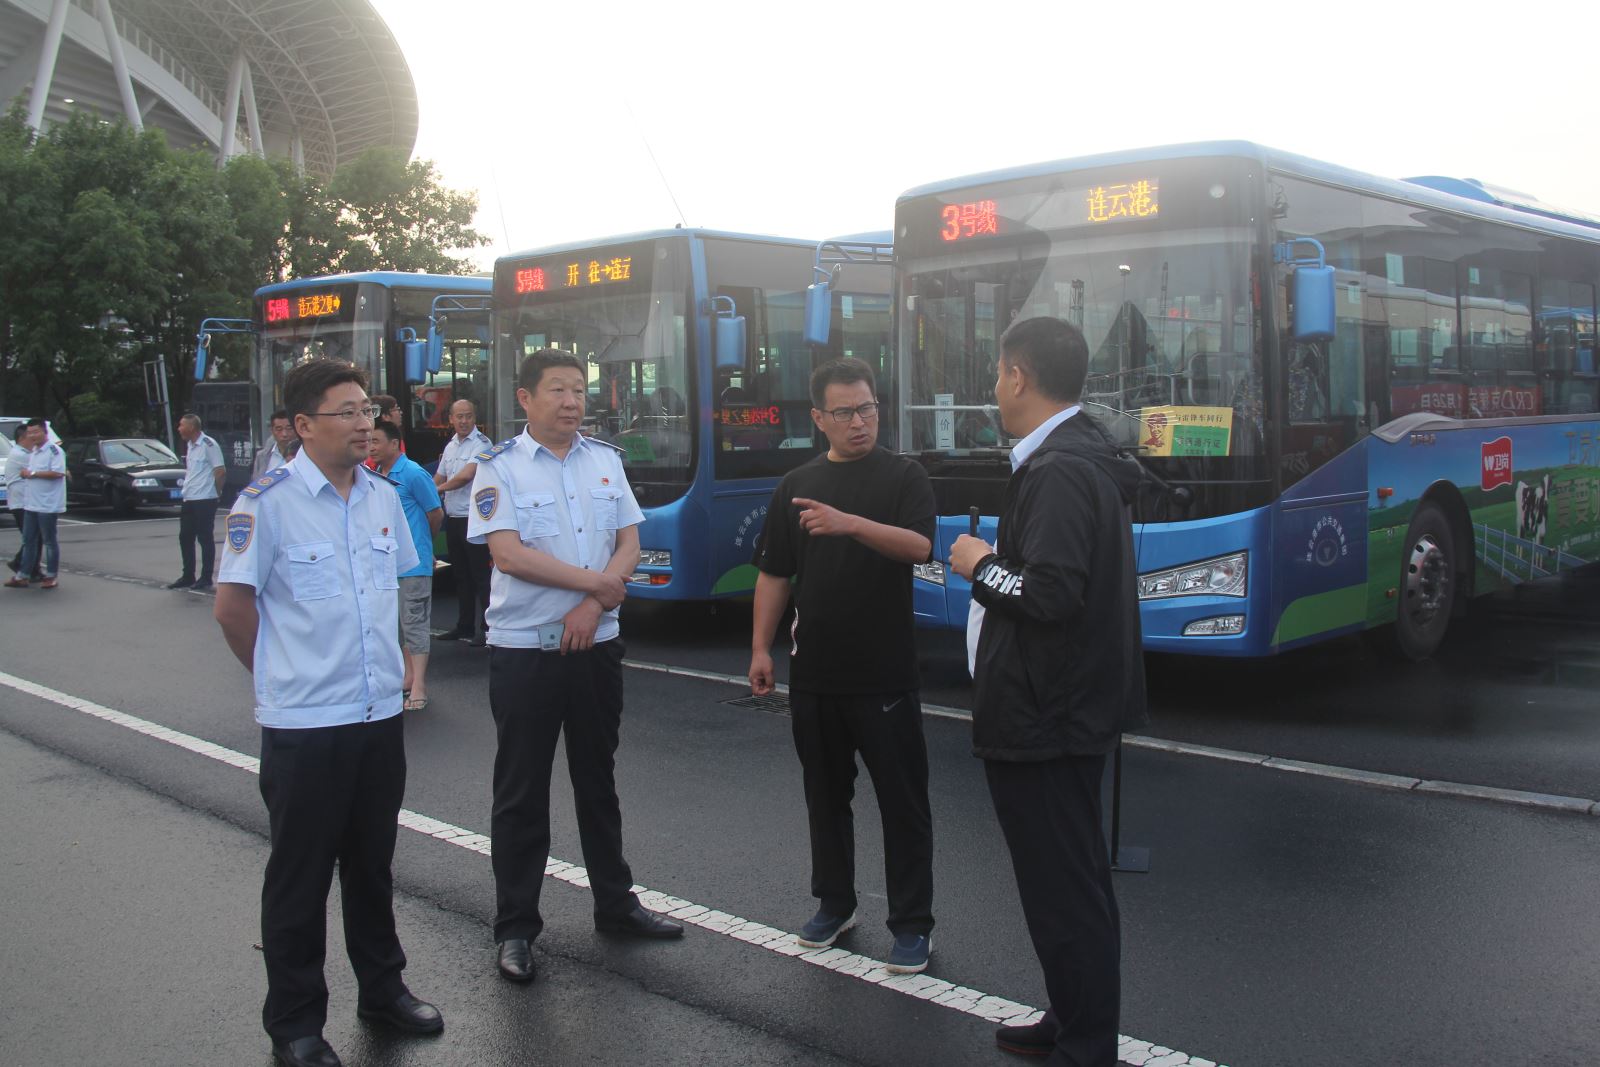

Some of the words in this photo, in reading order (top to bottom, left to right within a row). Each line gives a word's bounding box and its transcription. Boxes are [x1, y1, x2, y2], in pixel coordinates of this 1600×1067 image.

[942, 201, 997, 241] 3号线
[1088, 180, 1158, 222] 连云港
[516, 268, 545, 293] 5号线
